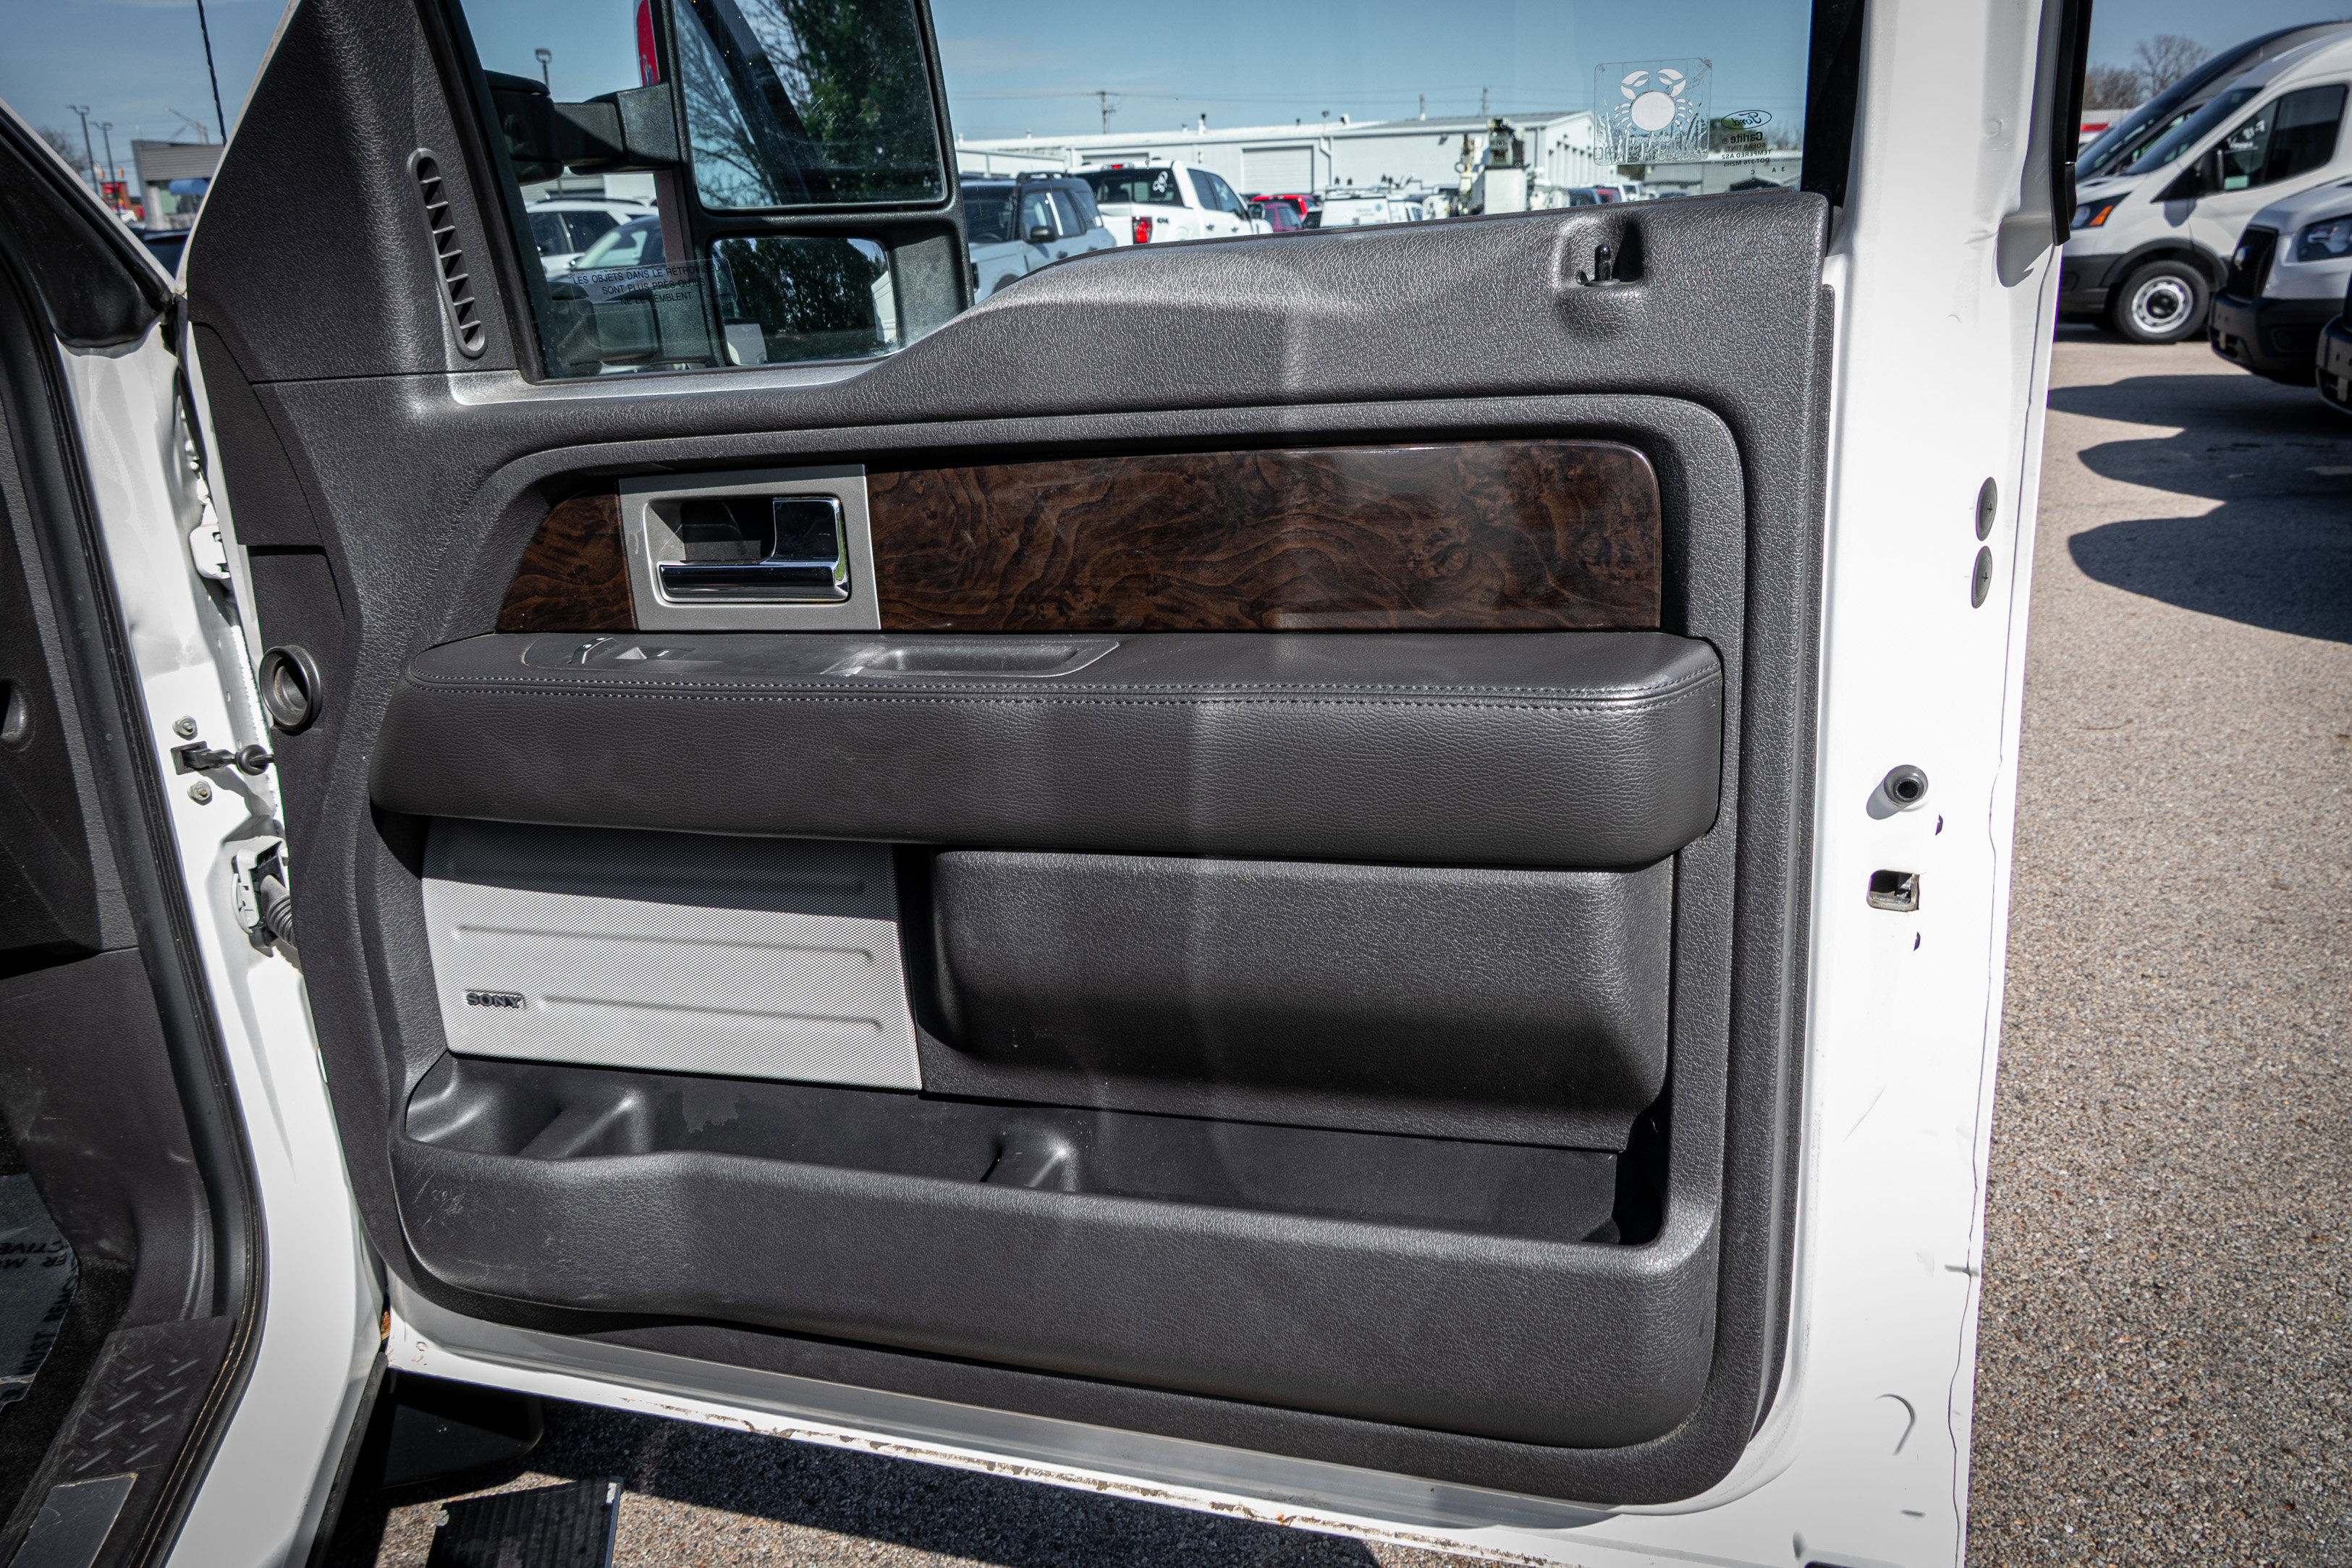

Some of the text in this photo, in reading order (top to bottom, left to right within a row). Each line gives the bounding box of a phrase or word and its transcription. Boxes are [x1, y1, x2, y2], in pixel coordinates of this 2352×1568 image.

[573, 276, 589, 285] LES
[591, 272, 624, 284] OBJETS
[626, 270, 650, 280] DANS
[652, 268, 664, 278] LE
[602, 284, 624, 295] SONT
[627, 282, 650, 292] PLUS
[652, 279, 675, 290] PRÈS
[466, 993, 523, 1009] SONY
